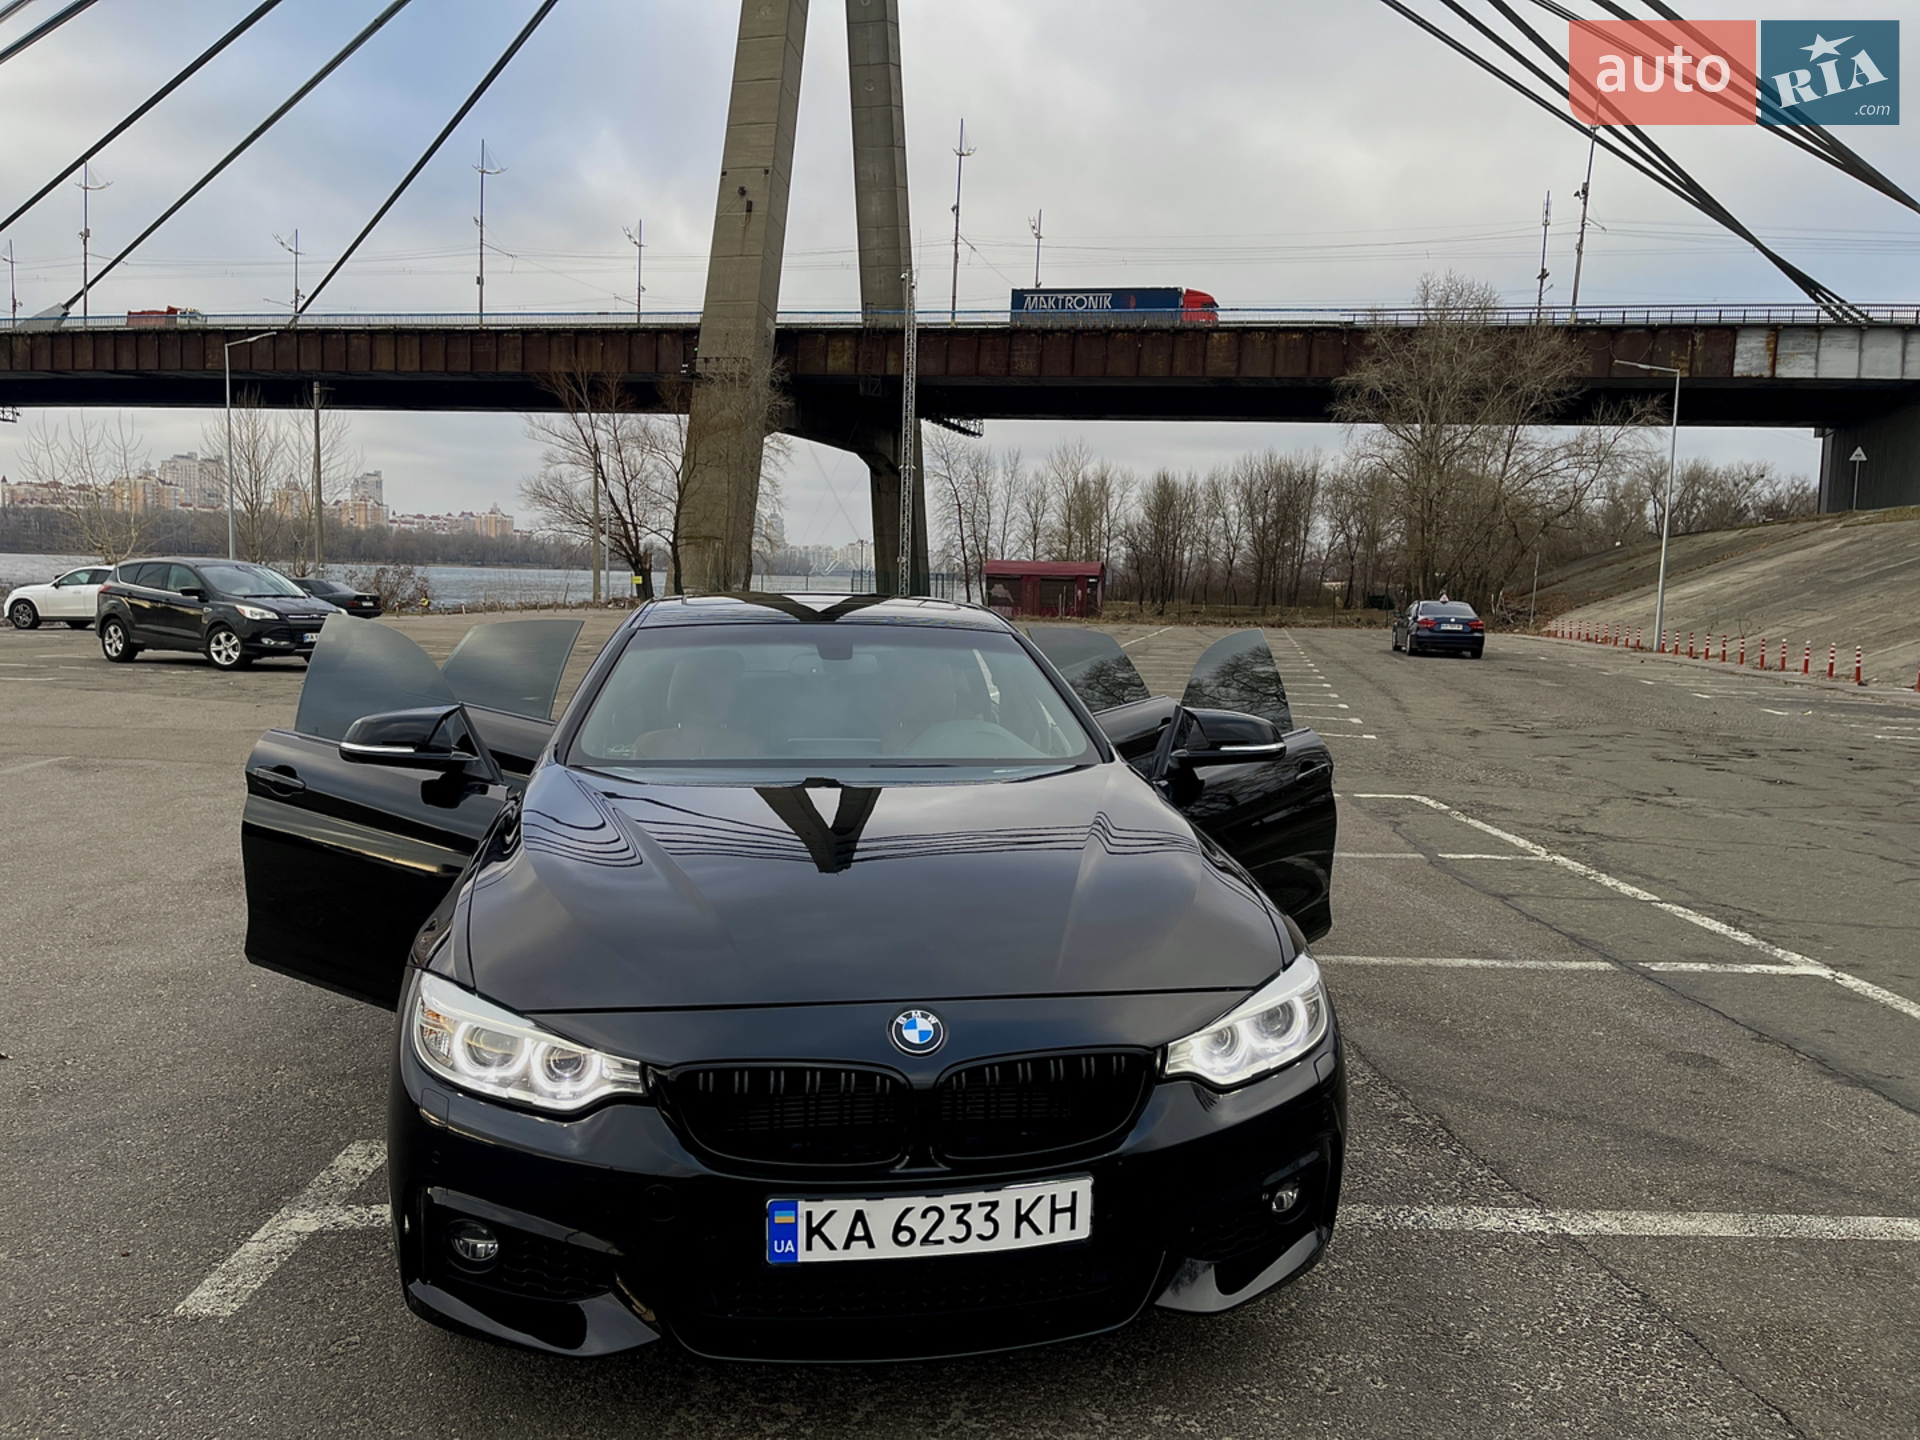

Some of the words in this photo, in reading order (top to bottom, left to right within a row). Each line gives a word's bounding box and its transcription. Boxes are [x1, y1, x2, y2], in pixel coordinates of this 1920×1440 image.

[1024, 294, 1112, 309] MAKTRONIK
[805, 1209, 876, 1251] KA
[891, 1200, 1000, 1247] 6233
[1014, 1191, 1078, 1239] KH
[774, 1239, 795, 1253] UA
